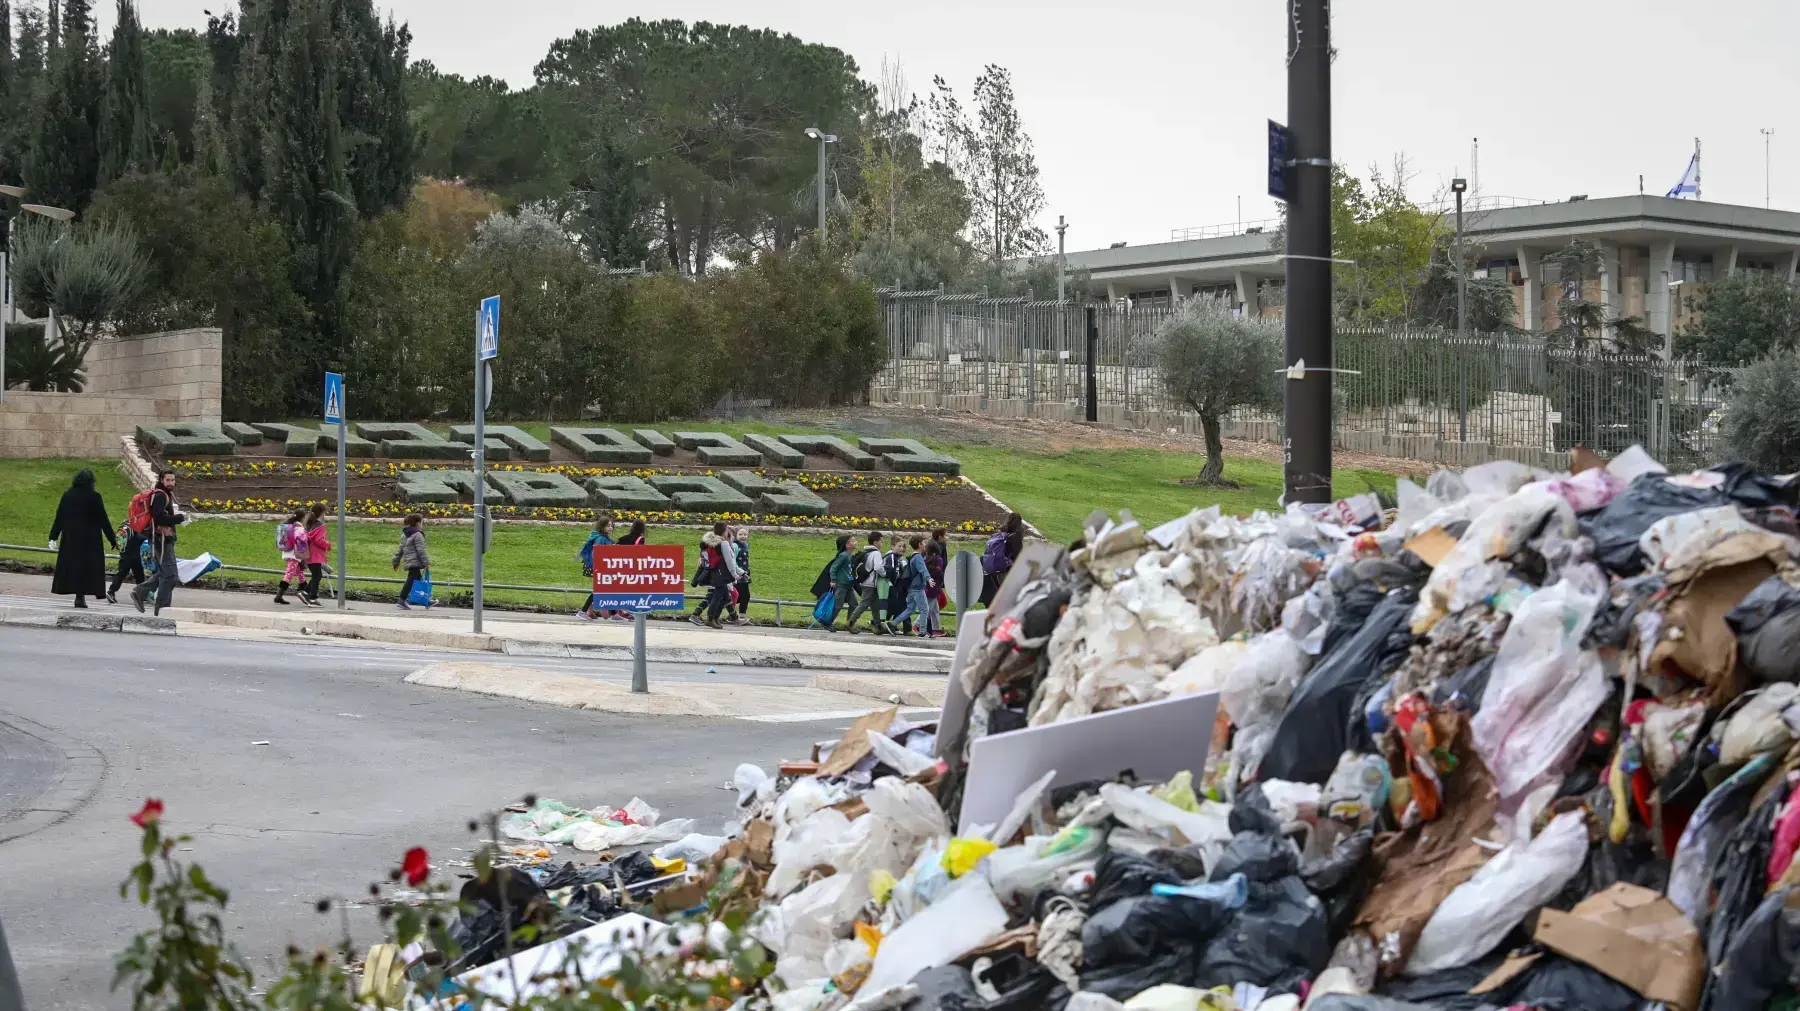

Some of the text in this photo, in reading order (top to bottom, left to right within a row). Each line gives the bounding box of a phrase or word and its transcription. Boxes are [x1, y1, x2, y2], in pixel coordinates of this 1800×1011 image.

[603, 556, 675, 570] כחלון ויתר
[597, 572, 681, 585] על ירושלים!
[636, 594, 653, 607] לא
